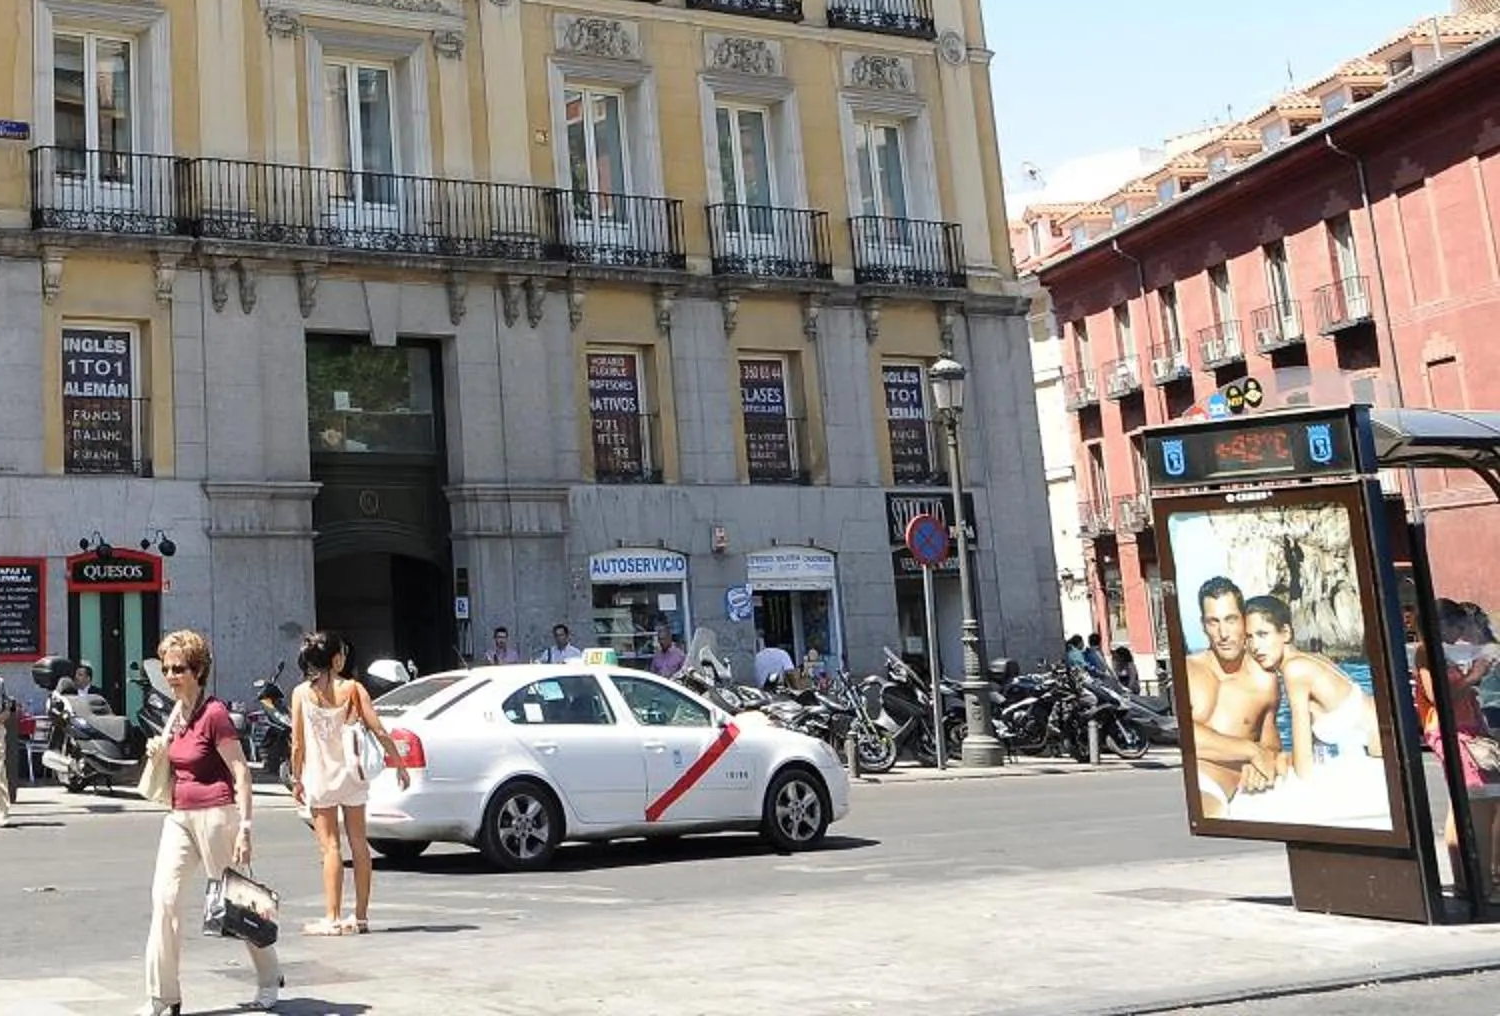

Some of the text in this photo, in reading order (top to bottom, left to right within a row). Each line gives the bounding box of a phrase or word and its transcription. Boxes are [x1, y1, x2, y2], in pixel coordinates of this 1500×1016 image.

[63, 336, 127, 354] INGLÉS
[64, 380, 128, 397] ALEMÁN
[83, 565, 143, 580] QUESOS
[592, 557, 685, 574] AUTOSERVICIO
